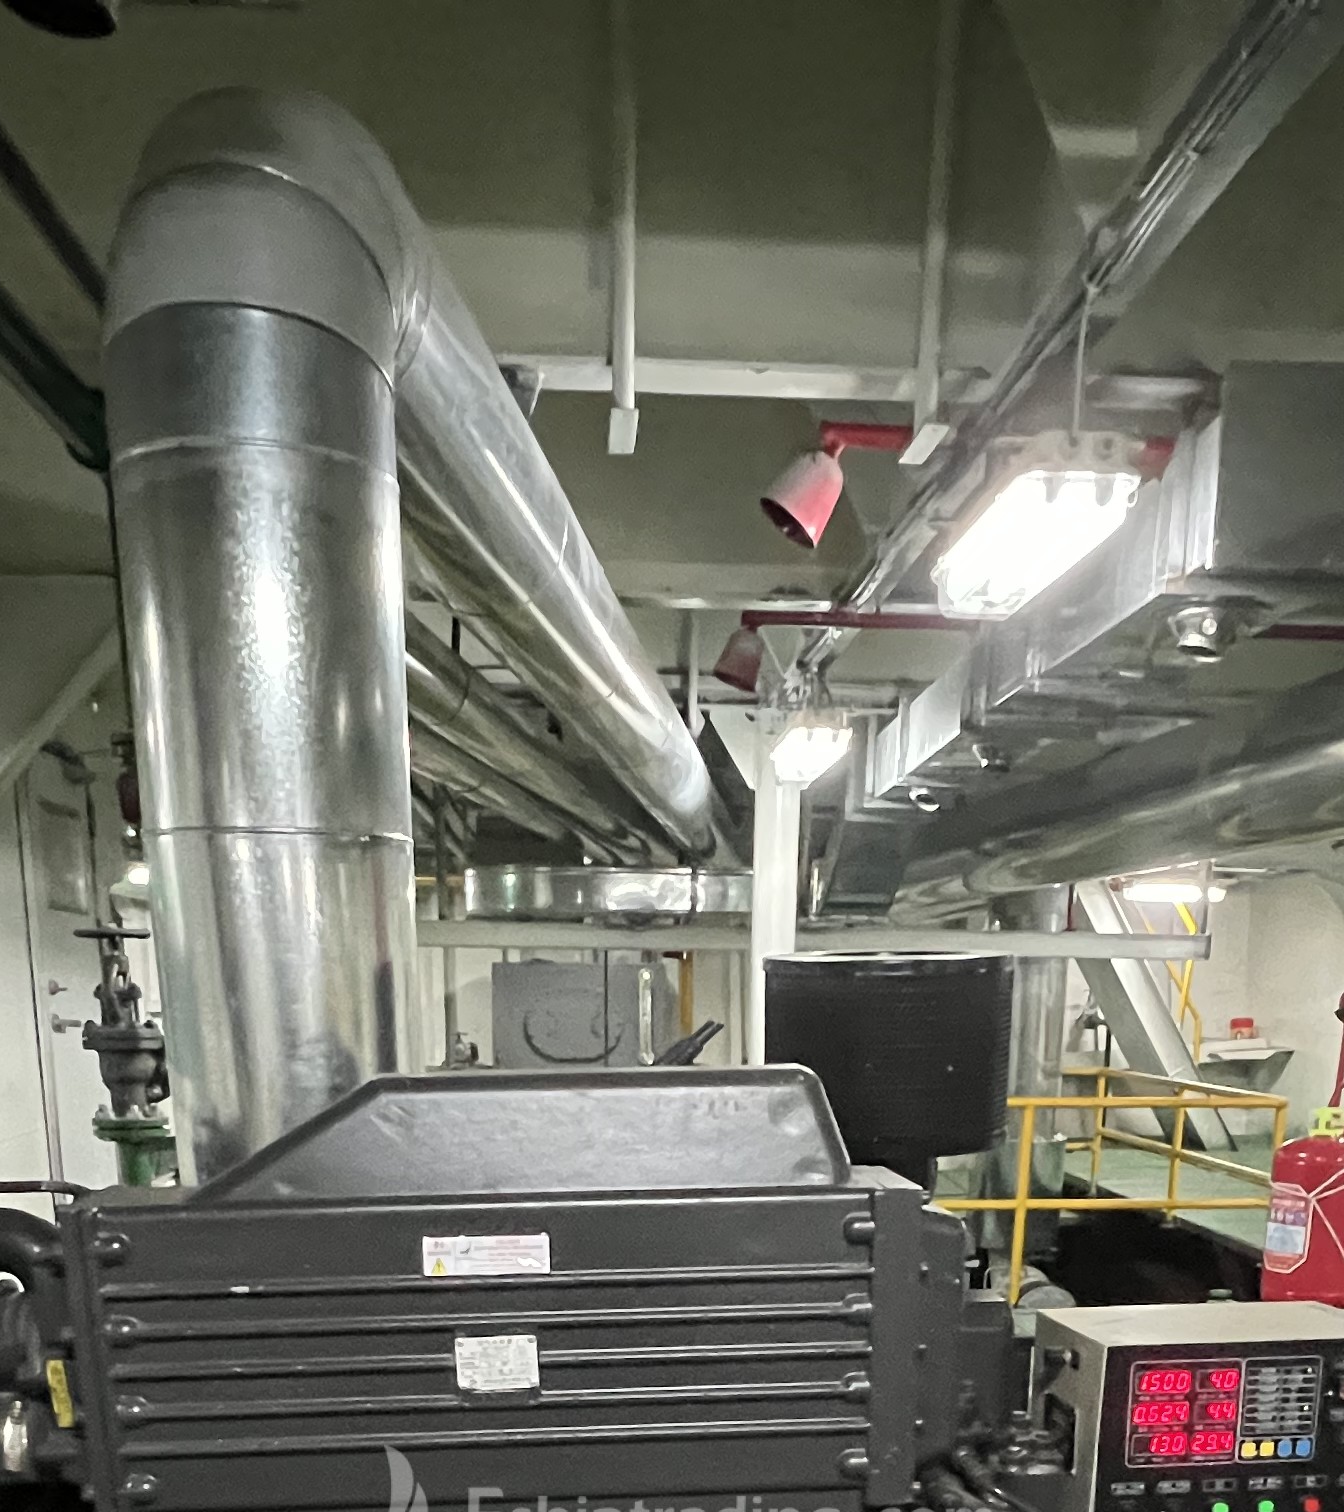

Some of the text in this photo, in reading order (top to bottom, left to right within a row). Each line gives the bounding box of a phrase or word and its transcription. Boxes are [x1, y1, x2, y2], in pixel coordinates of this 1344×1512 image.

[1140, 1372, 1189, 1391] 1500
[1209, 1370, 1239, 1389] 40
[1207, 1402, 1235, 1420] 44
[1149, 1434, 1185, 1453] 130
